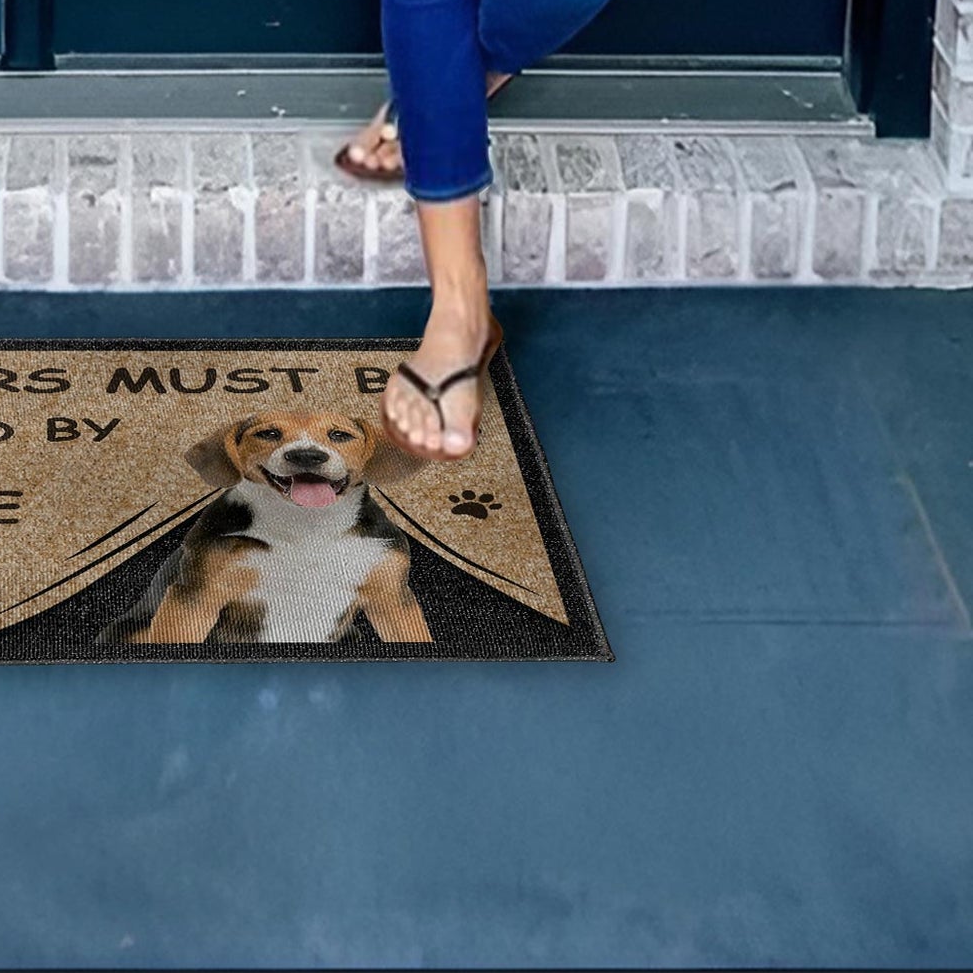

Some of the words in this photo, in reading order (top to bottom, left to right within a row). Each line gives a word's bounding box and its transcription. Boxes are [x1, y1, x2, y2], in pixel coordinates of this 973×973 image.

[105, 366, 320, 395] MUST
[354, 366, 391, 394] B
[46, 416, 122, 443] BY
